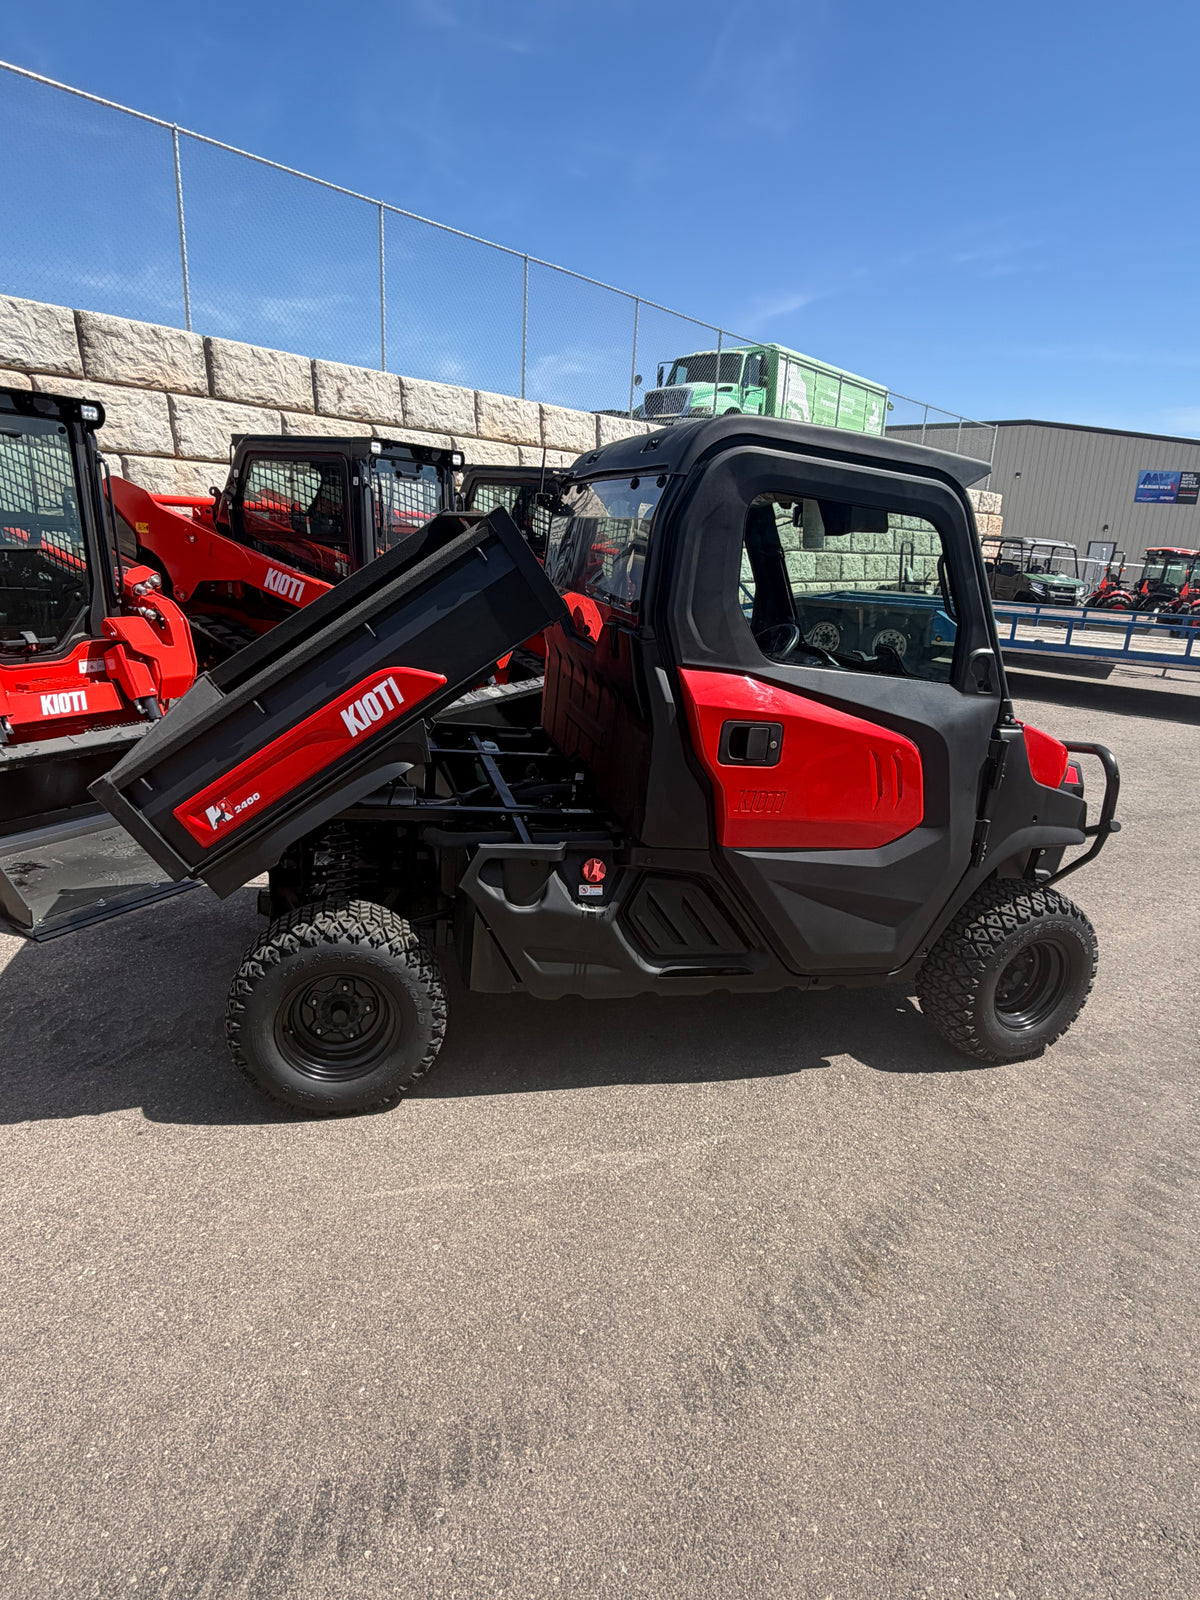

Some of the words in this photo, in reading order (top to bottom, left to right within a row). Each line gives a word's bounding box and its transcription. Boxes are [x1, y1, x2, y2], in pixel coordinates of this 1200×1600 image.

[263, 567, 305, 602] KIOTI
[40, 690, 88, 716] KIOTI
[340, 676, 405, 738] KIOTI
[234, 792, 261, 814] 2400
[733, 790, 787, 813] KIOTI
